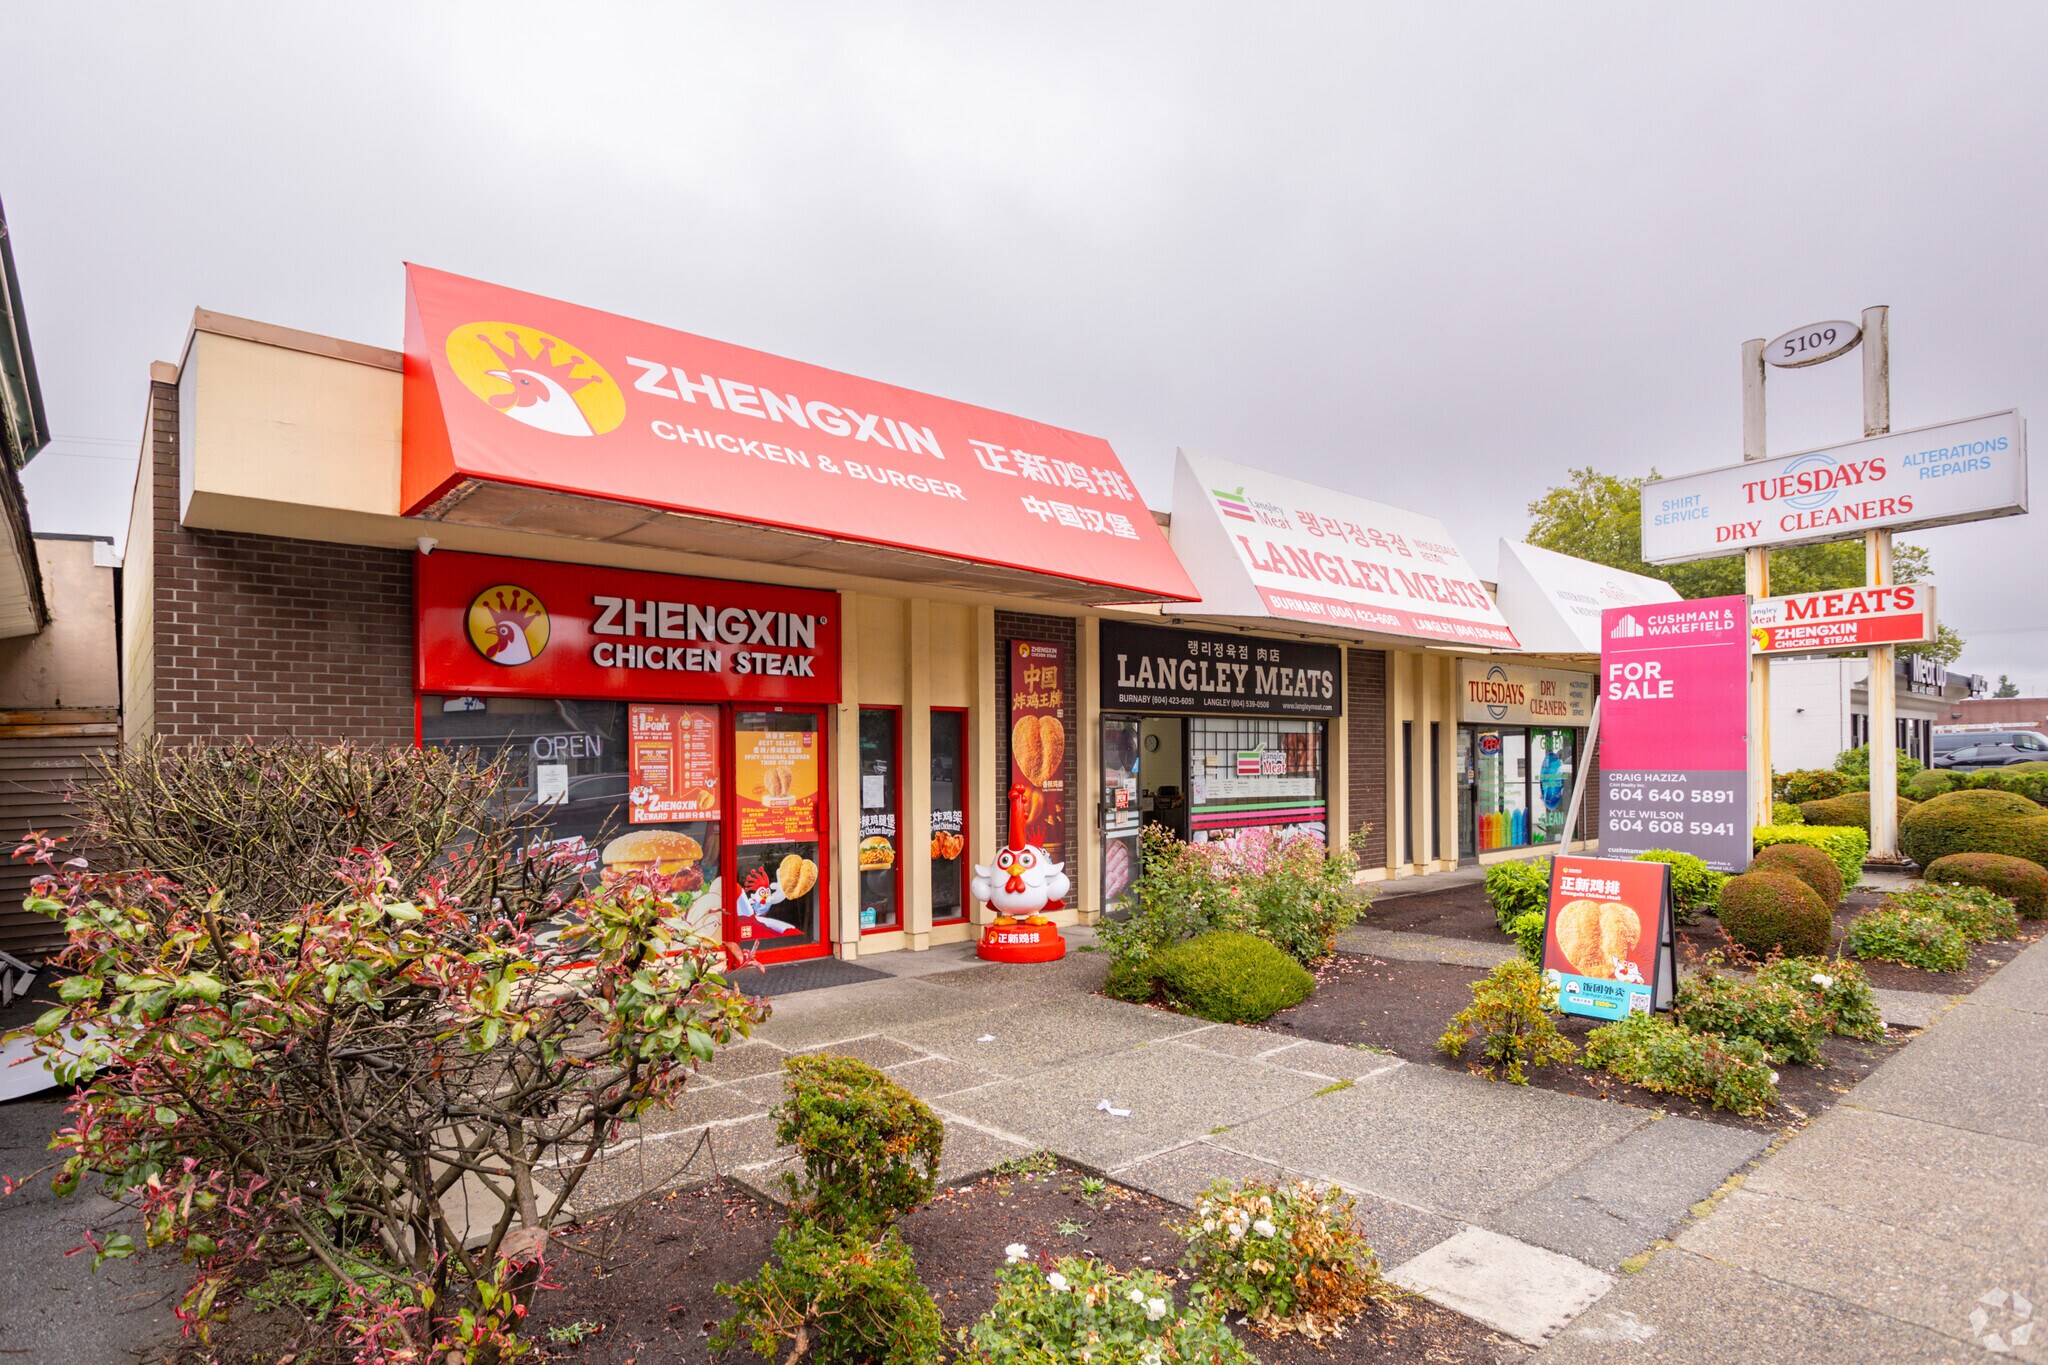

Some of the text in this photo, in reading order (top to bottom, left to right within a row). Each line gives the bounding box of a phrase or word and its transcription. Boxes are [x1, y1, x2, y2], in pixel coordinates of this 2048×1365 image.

[1784, 328, 1837, 358] 5109
[625, 356, 945, 460] ZHENGXIN
[650, 420, 968, 501] CHICKEN & BURGER
[1902, 437, 2008, 468] ALTERATIONS
[967, 438, 1135, 501] 正新鸡排
[1919, 456, 1991, 480] REPAIRS
[1742, 457, 1887, 504] TUESDAYS
[1248, 497, 1284, 516] Langley
[1662, 494, 1701, 512] SHIRT
[1020, 495, 1141, 541] 中国汉堡
[1256, 511, 1293, 531] Meat
[1654, 506, 1709, 526] SERVICE
[1715, 494, 1914, 543] DRY CLEANERS
[1295, 510, 1413, 558] 랭리정육점
[1412, 538, 1459, 557] WHOLESALE
[1421, 551, 1448, 566] RETAIL
[1237, 535, 1491, 611] LANGLEY MEATS
[1269, 595, 1401, 627] BURNABY (604) 423-6051
[1753, 607, 1777, 615] angley
[1785, 586, 1915, 621] MEATS
[593, 595, 815, 648] ZHENGXIN
[1648, 609, 1733, 625] CUSHMAN &
[1414, 618, 1454, 635] LANGLEY
[1455, 623, 1476, 638] (604)
[1648, 620, 1734, 636] WAKEFIELD
[1774, 622, 1857, 640] ZHENGXIN
[1031, 646, 1057, 654] ZHENGXIN
[1774, 634, 1857, 649] CHICKEN STEAK
[592, 642, 815, 677] CHICKEN STEAK
[1187, 640, 1280, 663] 랭리정육점 肉店
[1023, 663, 1058, 694] 中国
[1117, 654, 1333, 699] LANGLEY MEATS
[1609, 661, 1662, 682] FOR
[1468, 680, 1525, 705] TUESDAYS
[1540, 680, 1556, 696] DRY
[1608, 680, 1674, 701] SALE
[1012, 689, 1064, 711] 炸鸡王牌
[1119, 694, 1195, 706] BURNABY (604) 423-6051
[1203, 698, 1270, 709] LANGLEY (604) 539-0508
[1282, 703, 1333, 712] www.langleymeat.com
[1530, 698, 1567, 716] CLEANERS
[639, 713, 646, 731] 1
[645, 722, 670, 731] POINT
[533, 735, 601, 760] OPEN
[1482, 737, 1500, 751] OPEN
[1541, 736, 1564, 750] GREEN
[1262, 751, 1286, 763] Langley
[1262, 761, 1286, 774] Meat
[1609, 773, 1687, 783] CRAIG HAZIZA
[648, 794, 698, 812] ZHENGXIN
[1609, 789, 1734, 803] 604 640 5891
[634, 808, 668, 822] REWARD
[860, 814, 895, 829] 辣鸡腿堡
[930, 810, 963, 825] 炸鸡架
[1540, 812, 1564, 827] CLEAN
[1609, 809, 1684, 820] KYLE WILSON
[1609, 819, 1734, 836] 604 608 5941
[1560, 876, 1620, 895] 正新鸡排
[998, 932, 1040, 944] 正新鸡排
[1582, 982, 1626, 997] 饭团外卖
